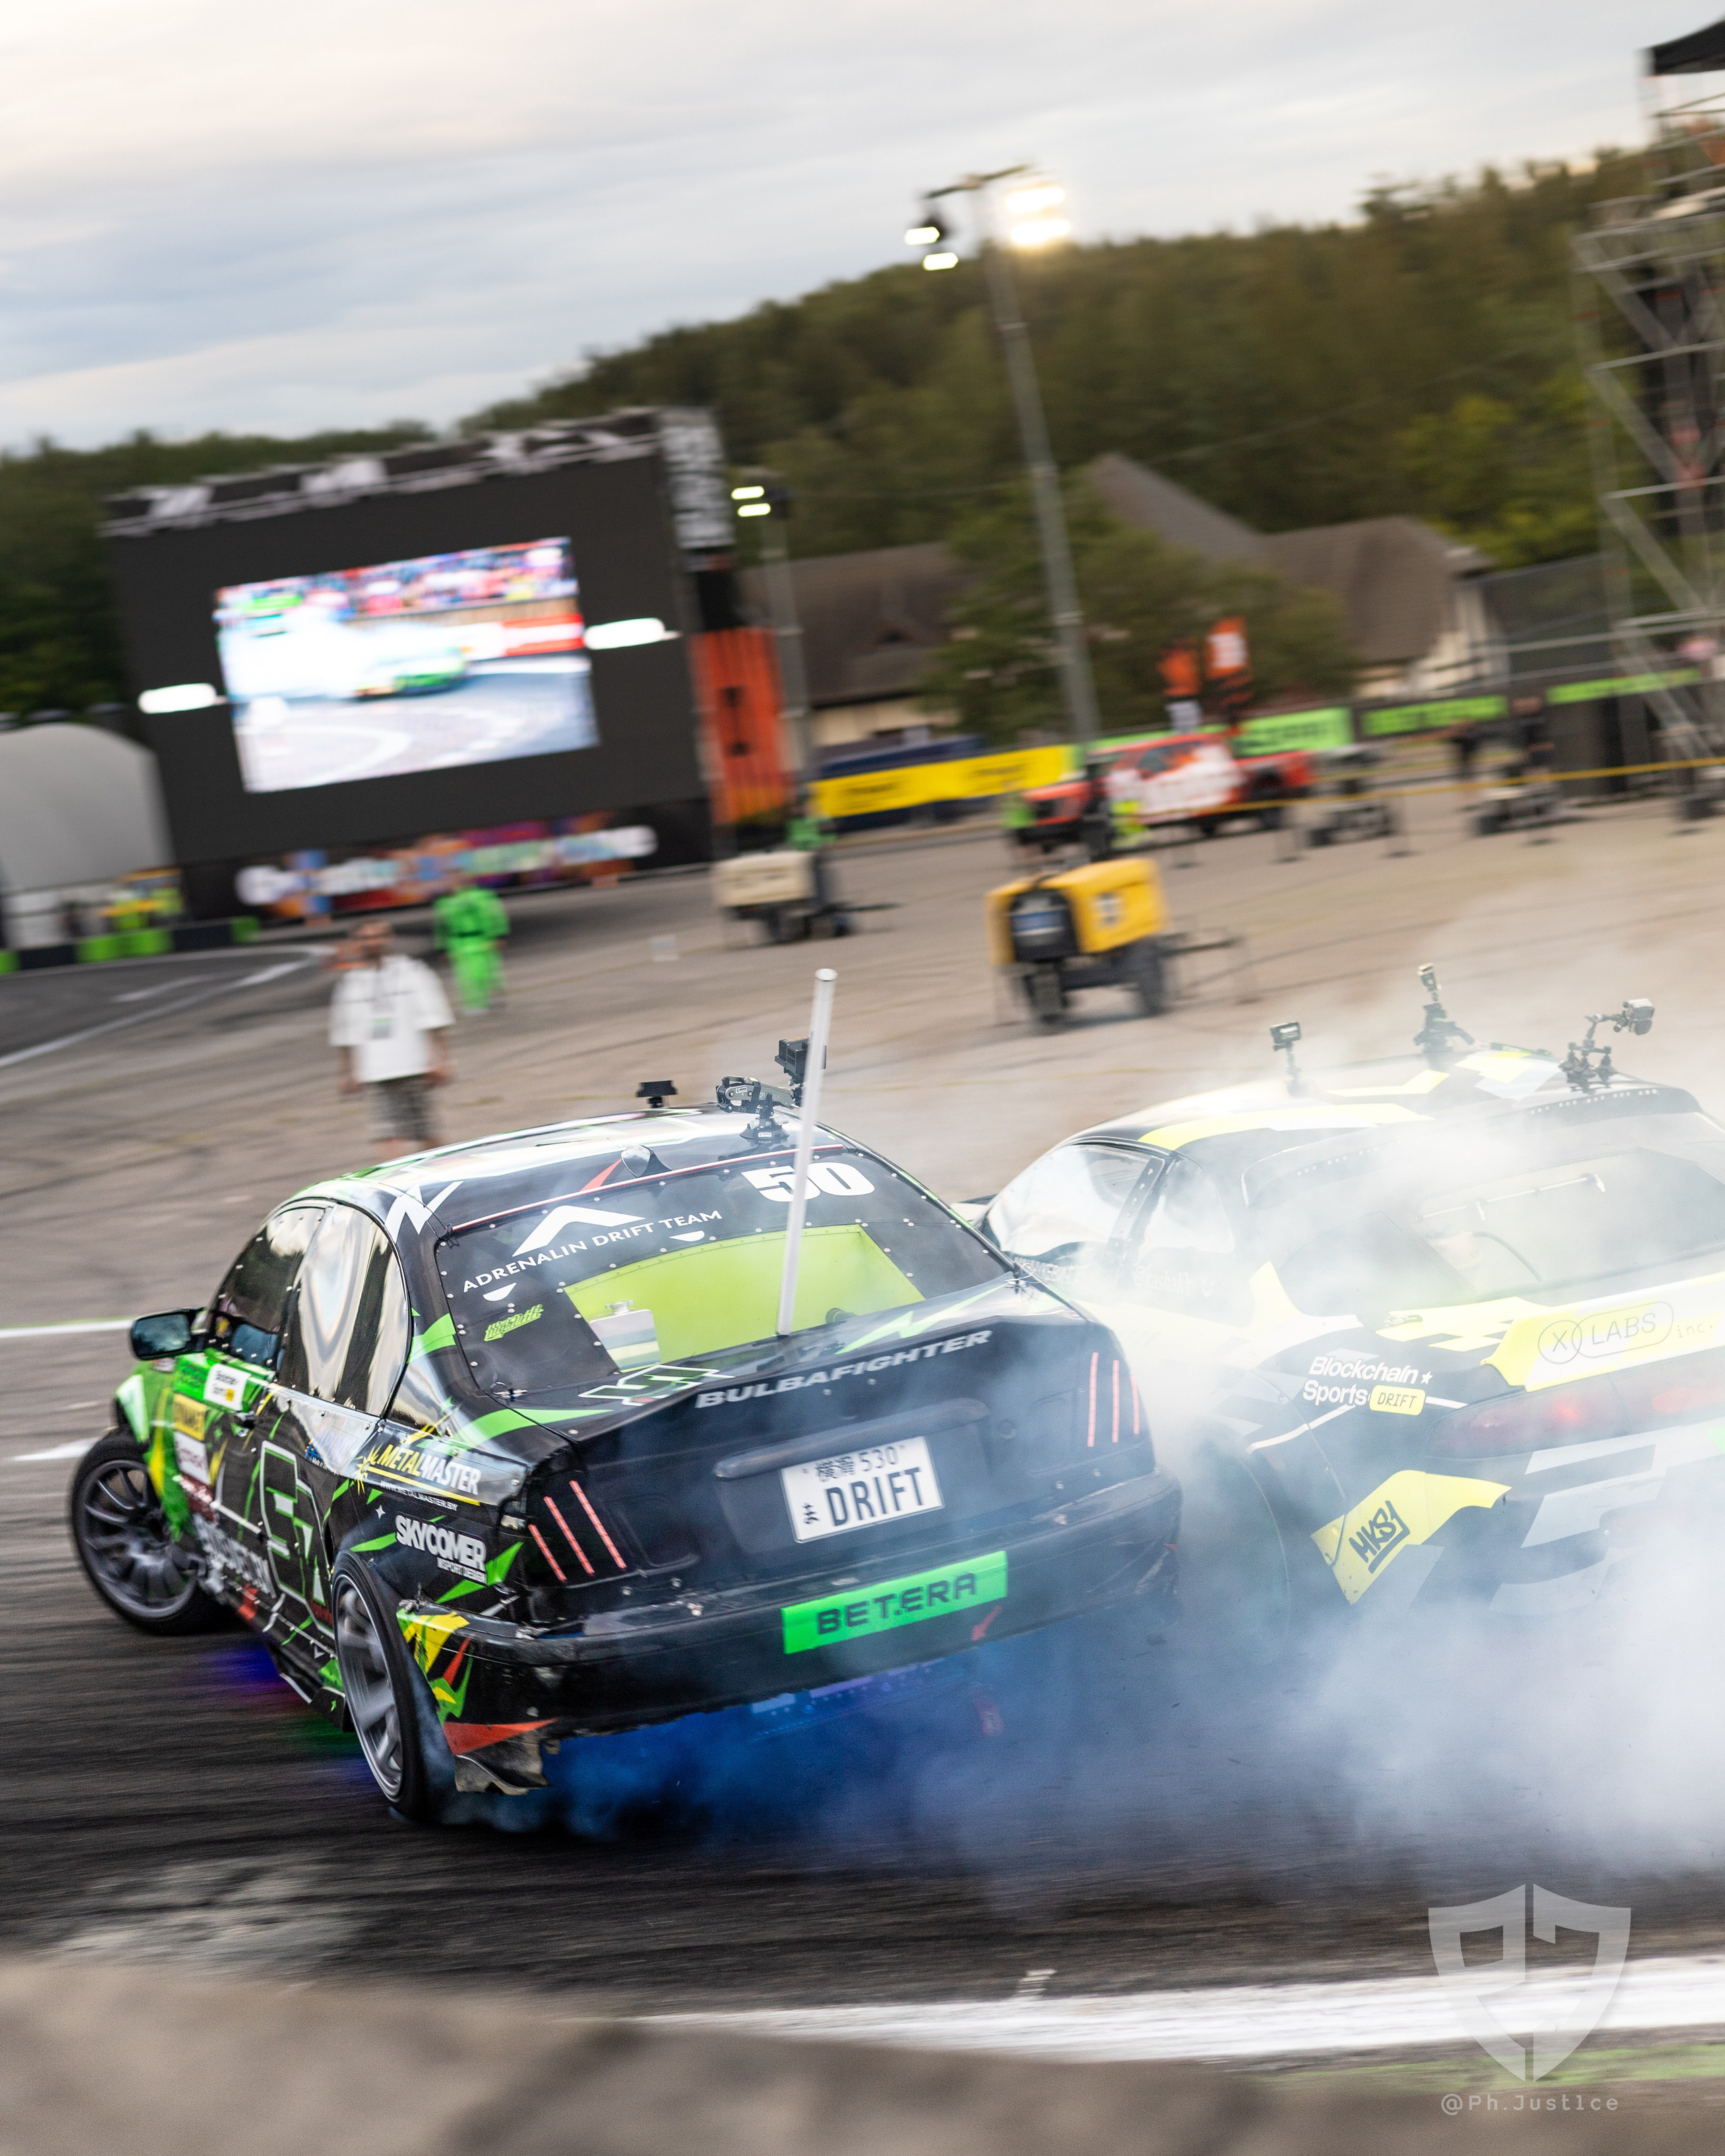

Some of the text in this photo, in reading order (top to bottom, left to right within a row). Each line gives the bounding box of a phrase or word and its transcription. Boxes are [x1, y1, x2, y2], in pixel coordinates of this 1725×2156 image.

[741, 1162, 875, 1202] 50
[463, 1210, 723, 1292] ADRENALIN DRIFT TEAM
[1552, 1312, 1714, 1352] X LABS inc.
[695, 1330, 993, 1409] BULBAFIGHTER
[1303, 1379, 1417, 1409] Sports DRIFT
[1309, 1356, 1419, 1385] Blockchain
[376, 1444, 482, 1496] METALMASTER
[858, 1446, 899, 1472] 530
[824, 1467, 923, 1527] DRIFT
[395, 1515, 487, 1573] SKYCOMER
[817, 1573, 976, 1635] BET.ERA
